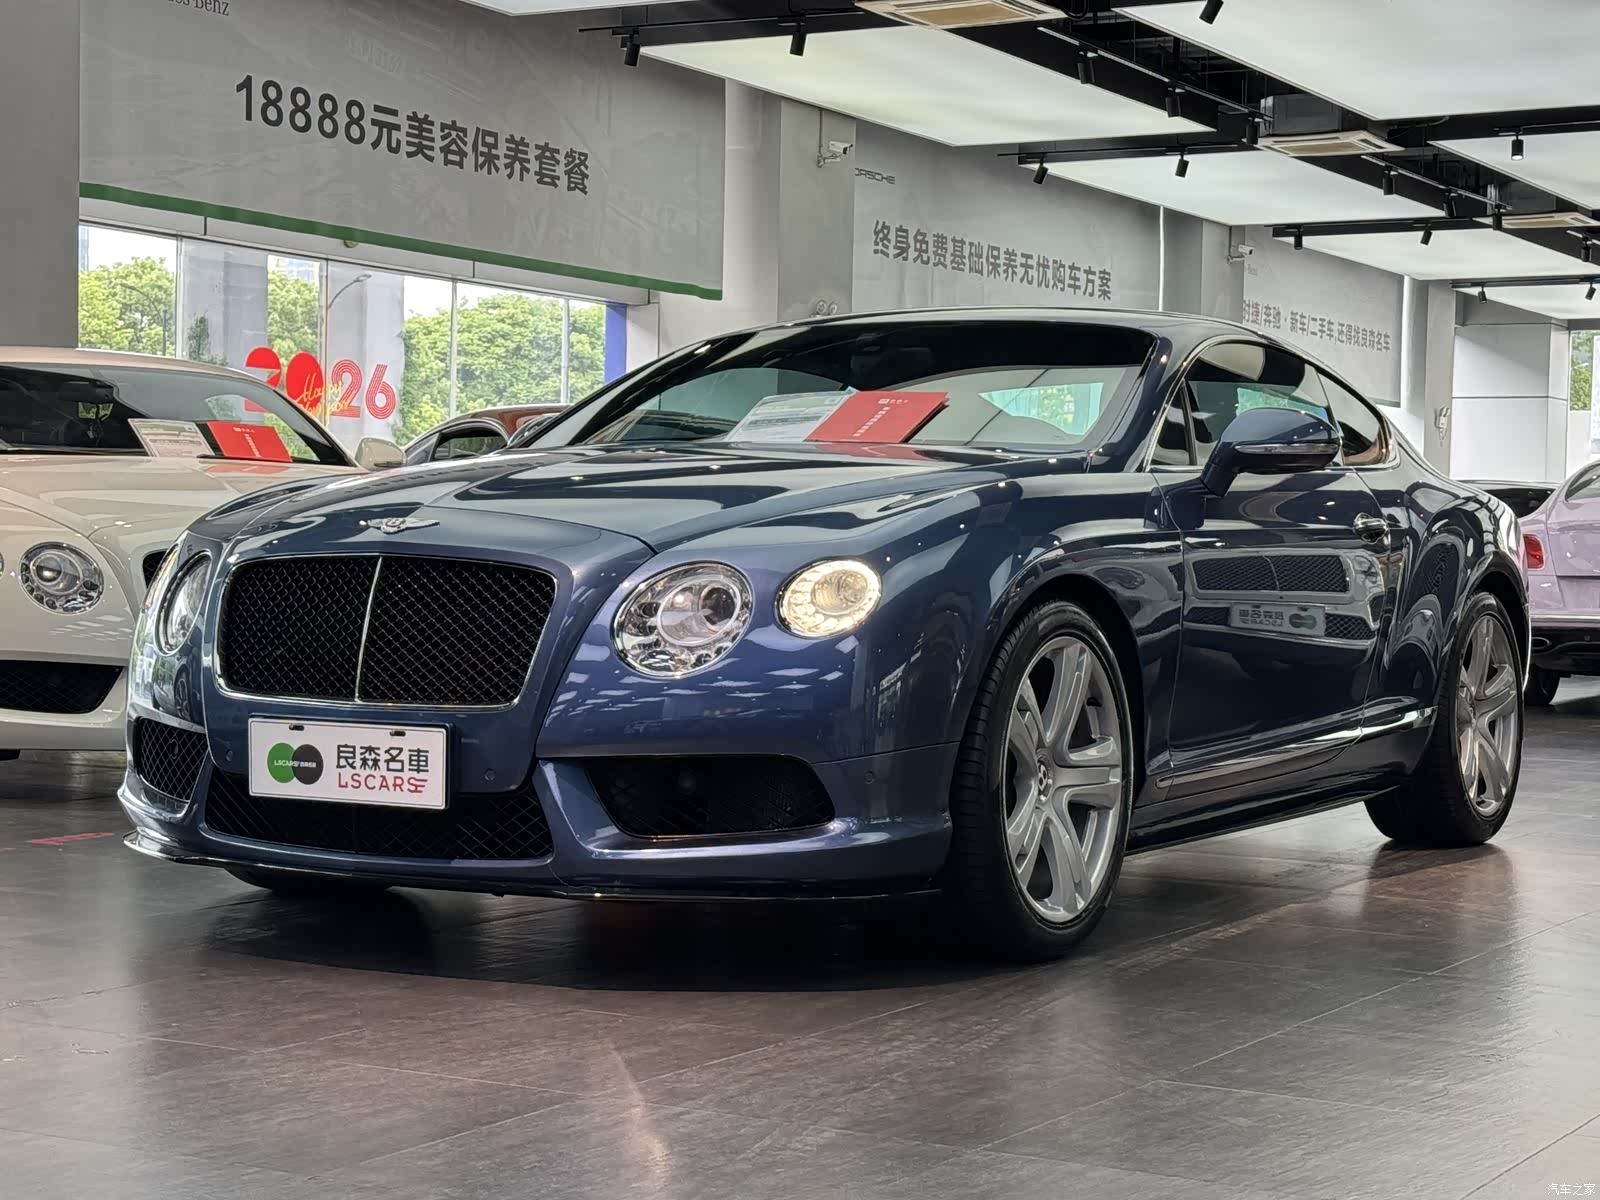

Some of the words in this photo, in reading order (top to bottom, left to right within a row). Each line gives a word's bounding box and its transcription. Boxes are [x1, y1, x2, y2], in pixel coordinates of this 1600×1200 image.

[236, 74, 590, 195] 18888元美容保养套餐
[873, 219, 1112, 301] 终身免费基础保养无忧购车方案
[336, 744, 429, 774] 良森名車
[338, 772, 428, 793] LSCARS
